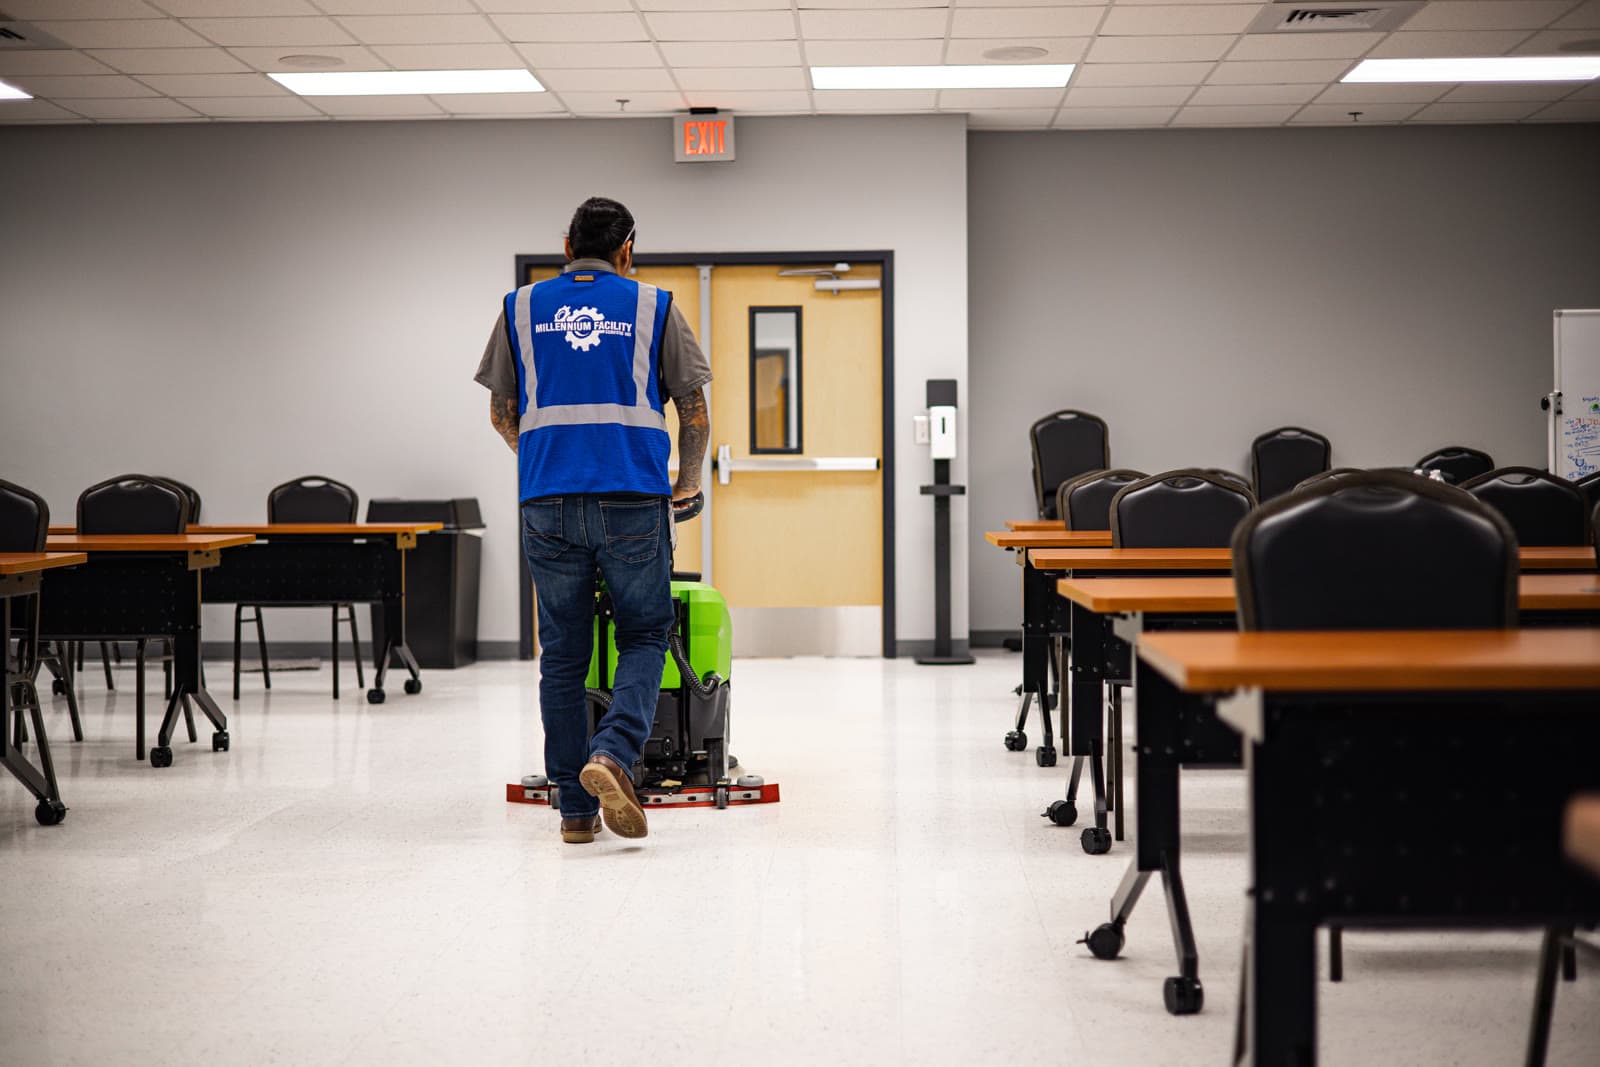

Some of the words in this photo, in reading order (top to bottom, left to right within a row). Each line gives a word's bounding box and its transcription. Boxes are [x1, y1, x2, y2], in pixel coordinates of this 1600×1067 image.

[684, 120, 727, 154] EXIT
[535, 321, 591, 333] MILLENNIUM
[594, 320, 632, 332] FACILITY
